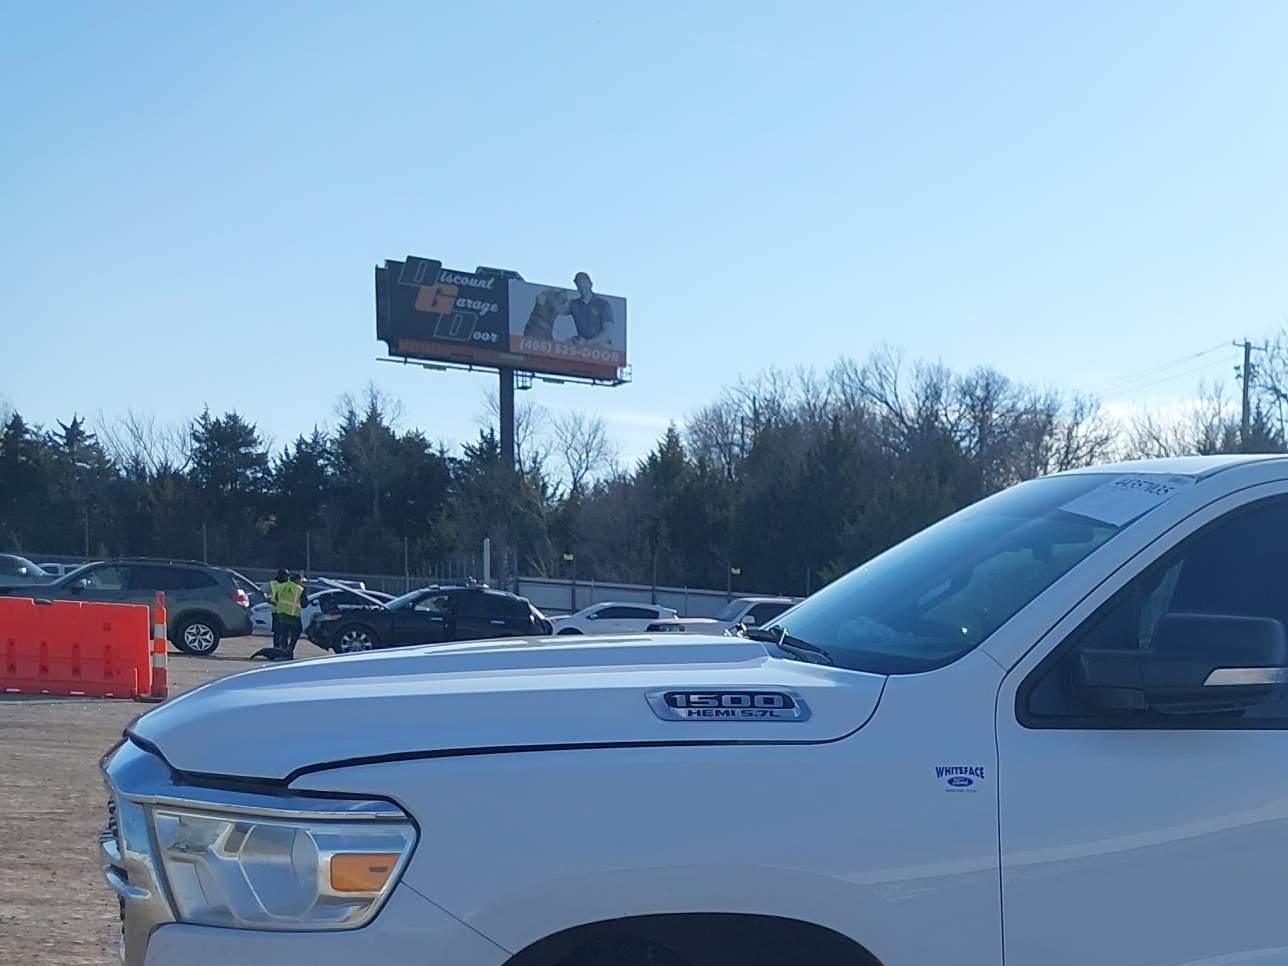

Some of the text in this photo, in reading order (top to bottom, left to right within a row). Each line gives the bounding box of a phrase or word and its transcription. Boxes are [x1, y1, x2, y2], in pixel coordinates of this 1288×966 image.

[398, 256, 495, 290] Discount
[415, 283, 499, 317] Garage
[433, 311, 498, 343] Door
[671, 694, 784, 708] 1500
[687, 709, 781, 718] HEMI 5.7L
[935, 766, 985, 779] WHITEFACE
